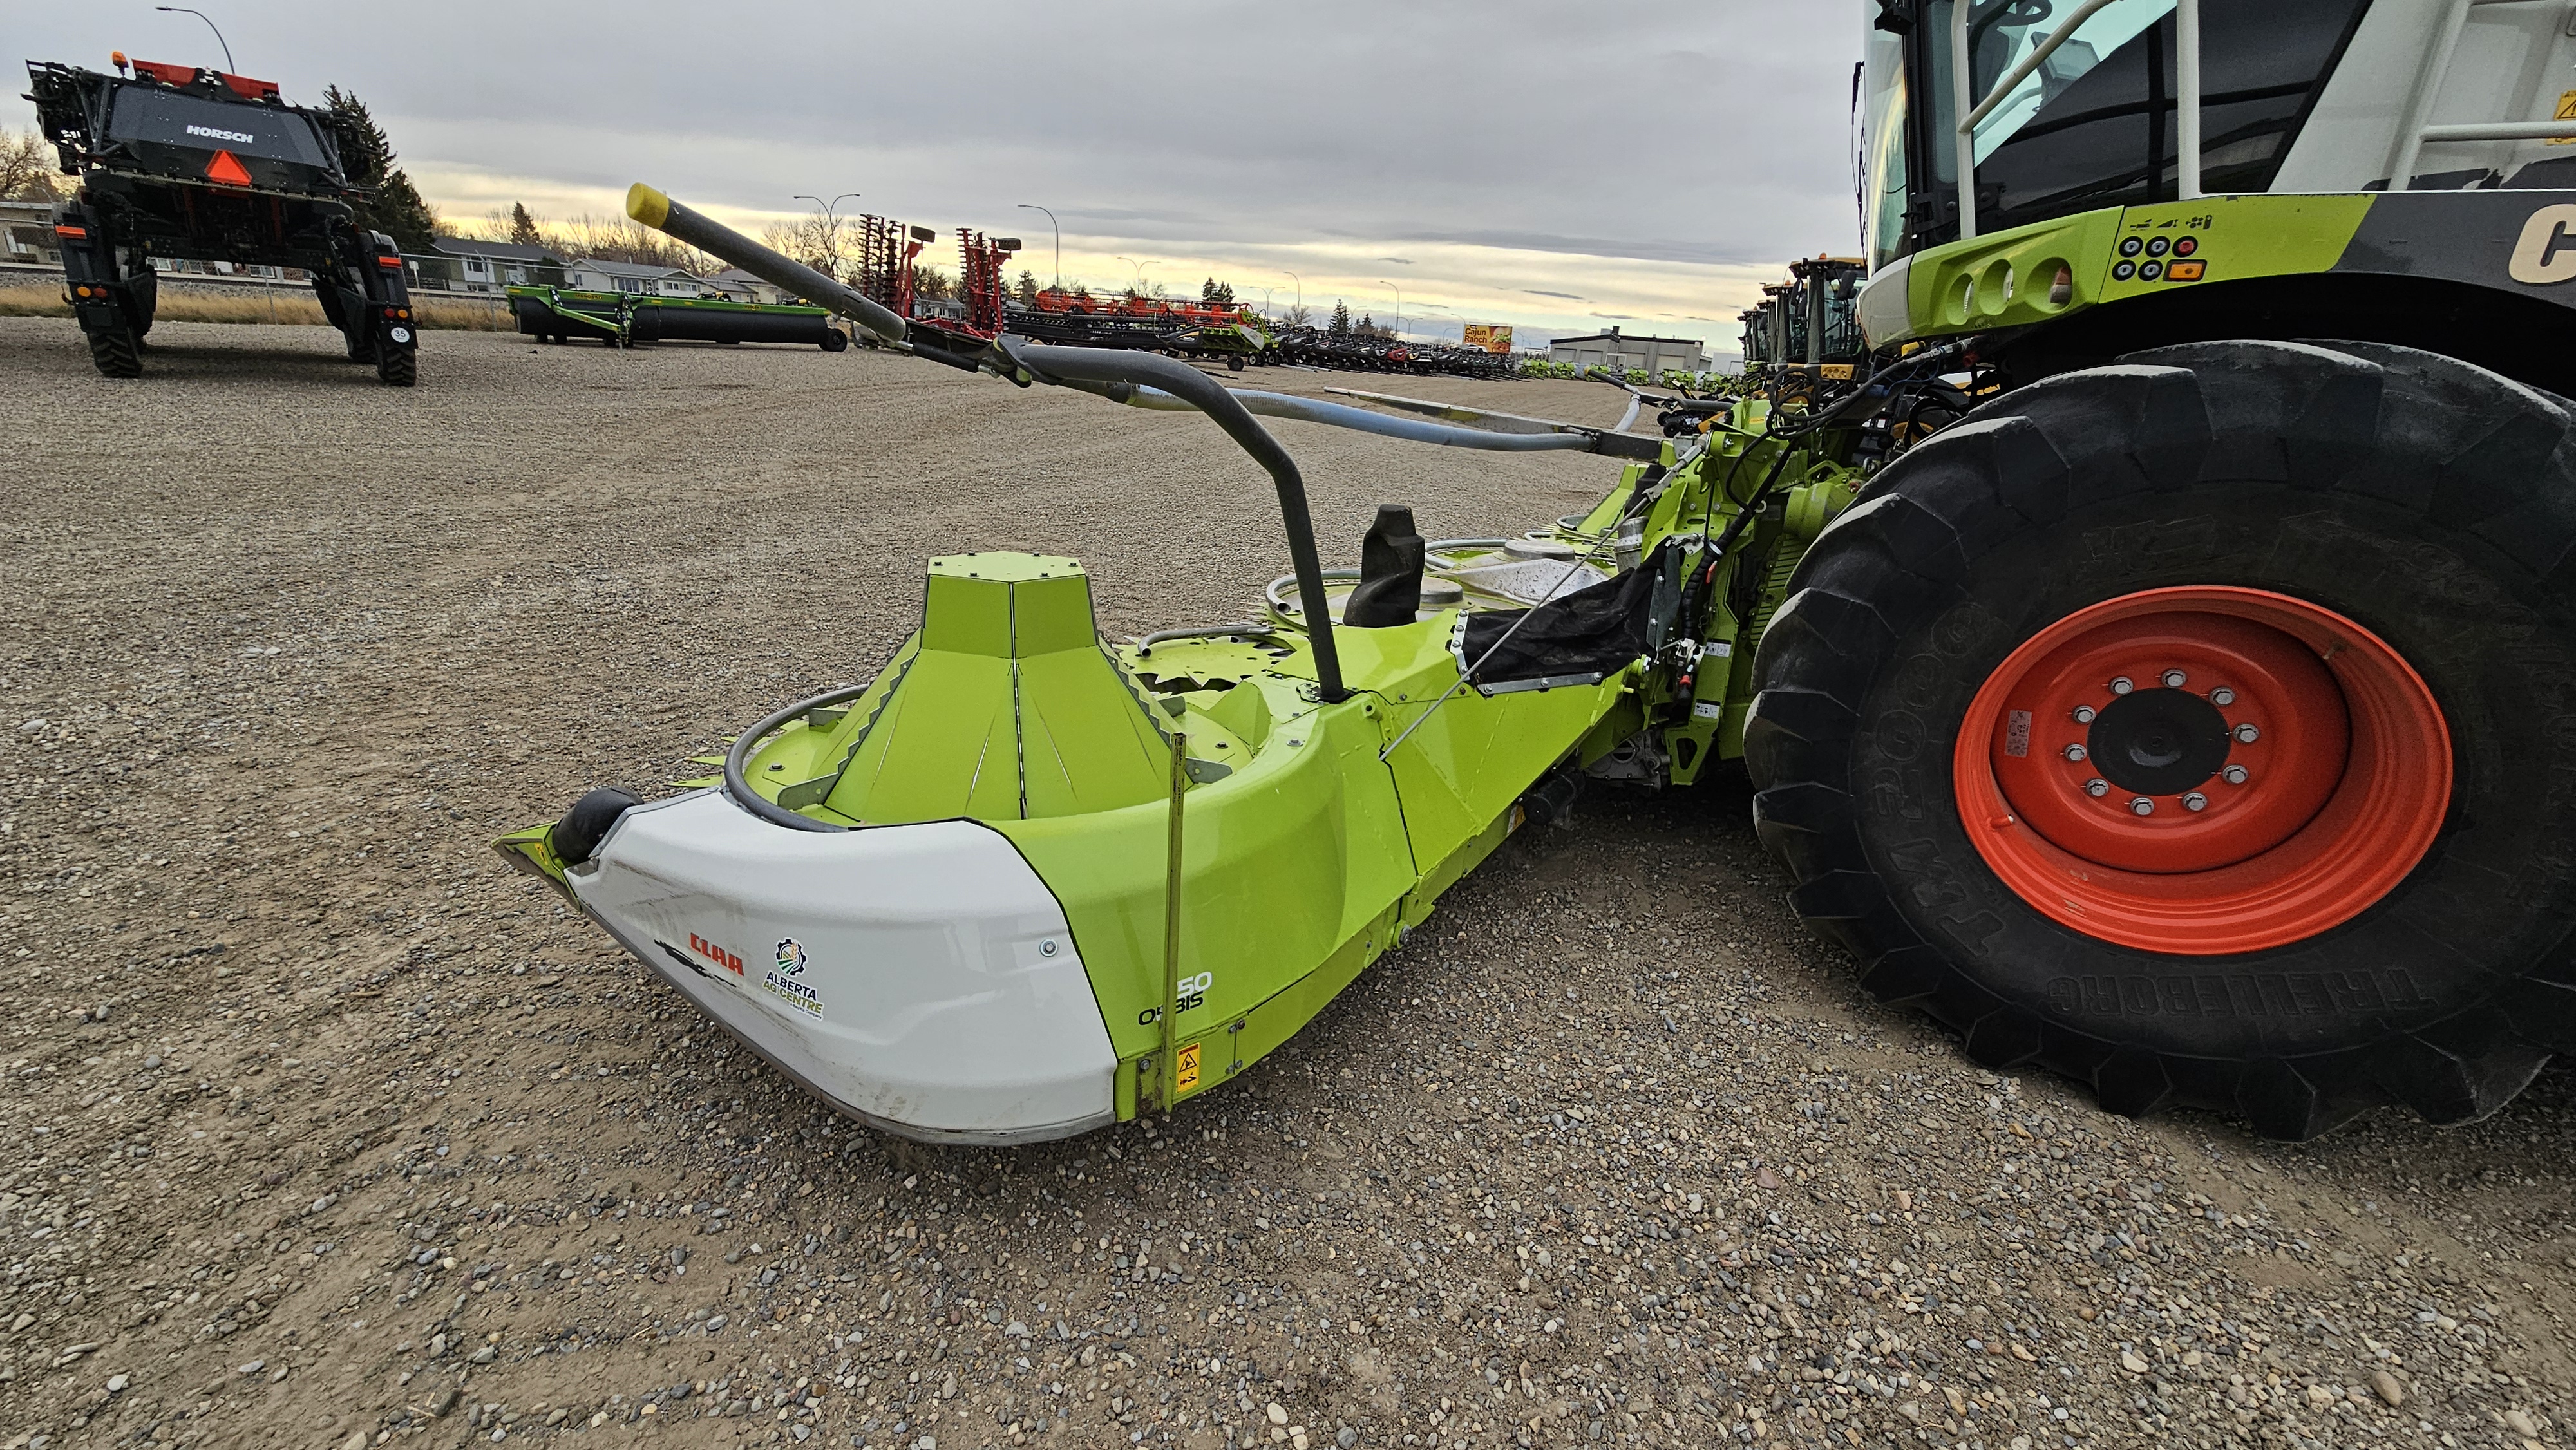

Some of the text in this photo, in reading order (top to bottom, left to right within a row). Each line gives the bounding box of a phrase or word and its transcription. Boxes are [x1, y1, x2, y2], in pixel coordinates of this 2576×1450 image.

[187, 124, 254, 144] HORSCH
[1465, 328, 1486, 337] Cajun
[763, 980, 777, 993] AG
[779, 989, 823, 1013] CENTRE
[766, 971, 817, 1001] ALBERTA
[2047, 966, 2439, 1016] TRELLEBORG
